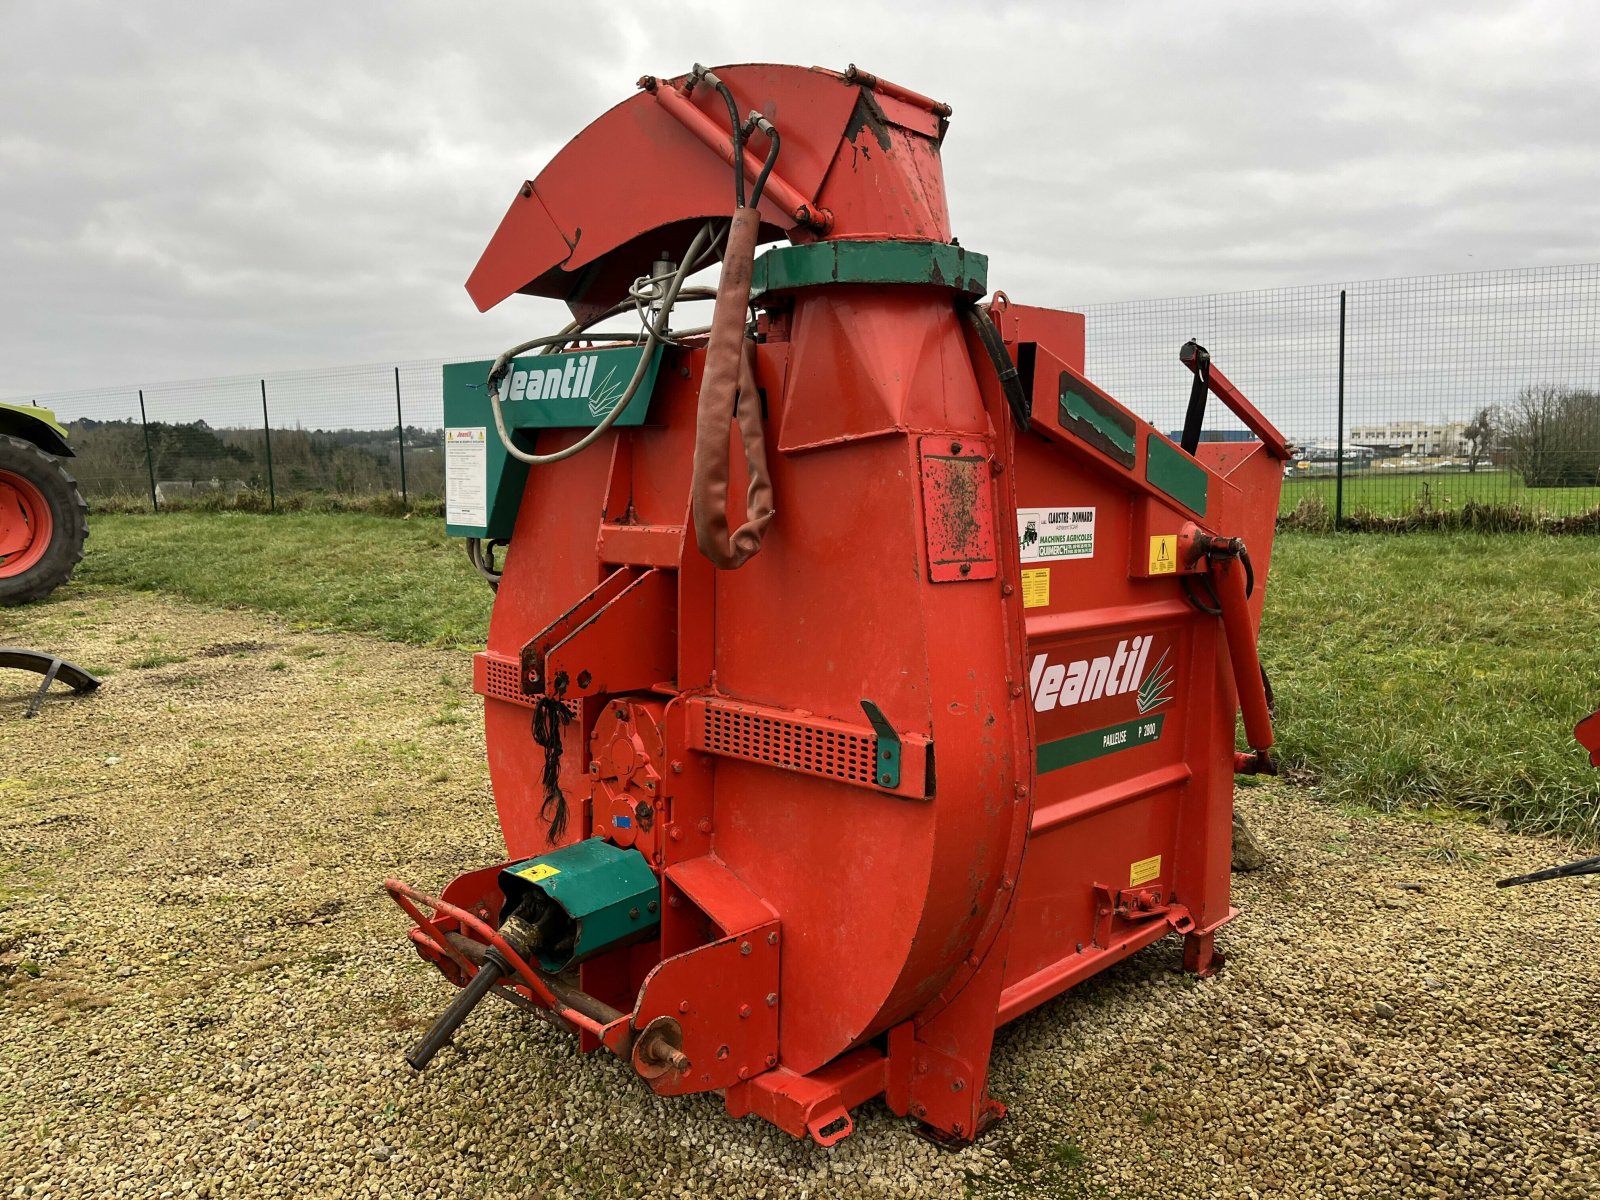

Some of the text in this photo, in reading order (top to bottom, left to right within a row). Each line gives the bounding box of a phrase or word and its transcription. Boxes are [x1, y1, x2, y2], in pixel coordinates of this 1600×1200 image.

[498, 355, 598, 401] Jeantil
[1040, 534, 1092, 543] MACHINES AGRICOLES
[1103, 730, 1127, 748] PAILLEUSE
[1138, 726, 1143, 738] P
